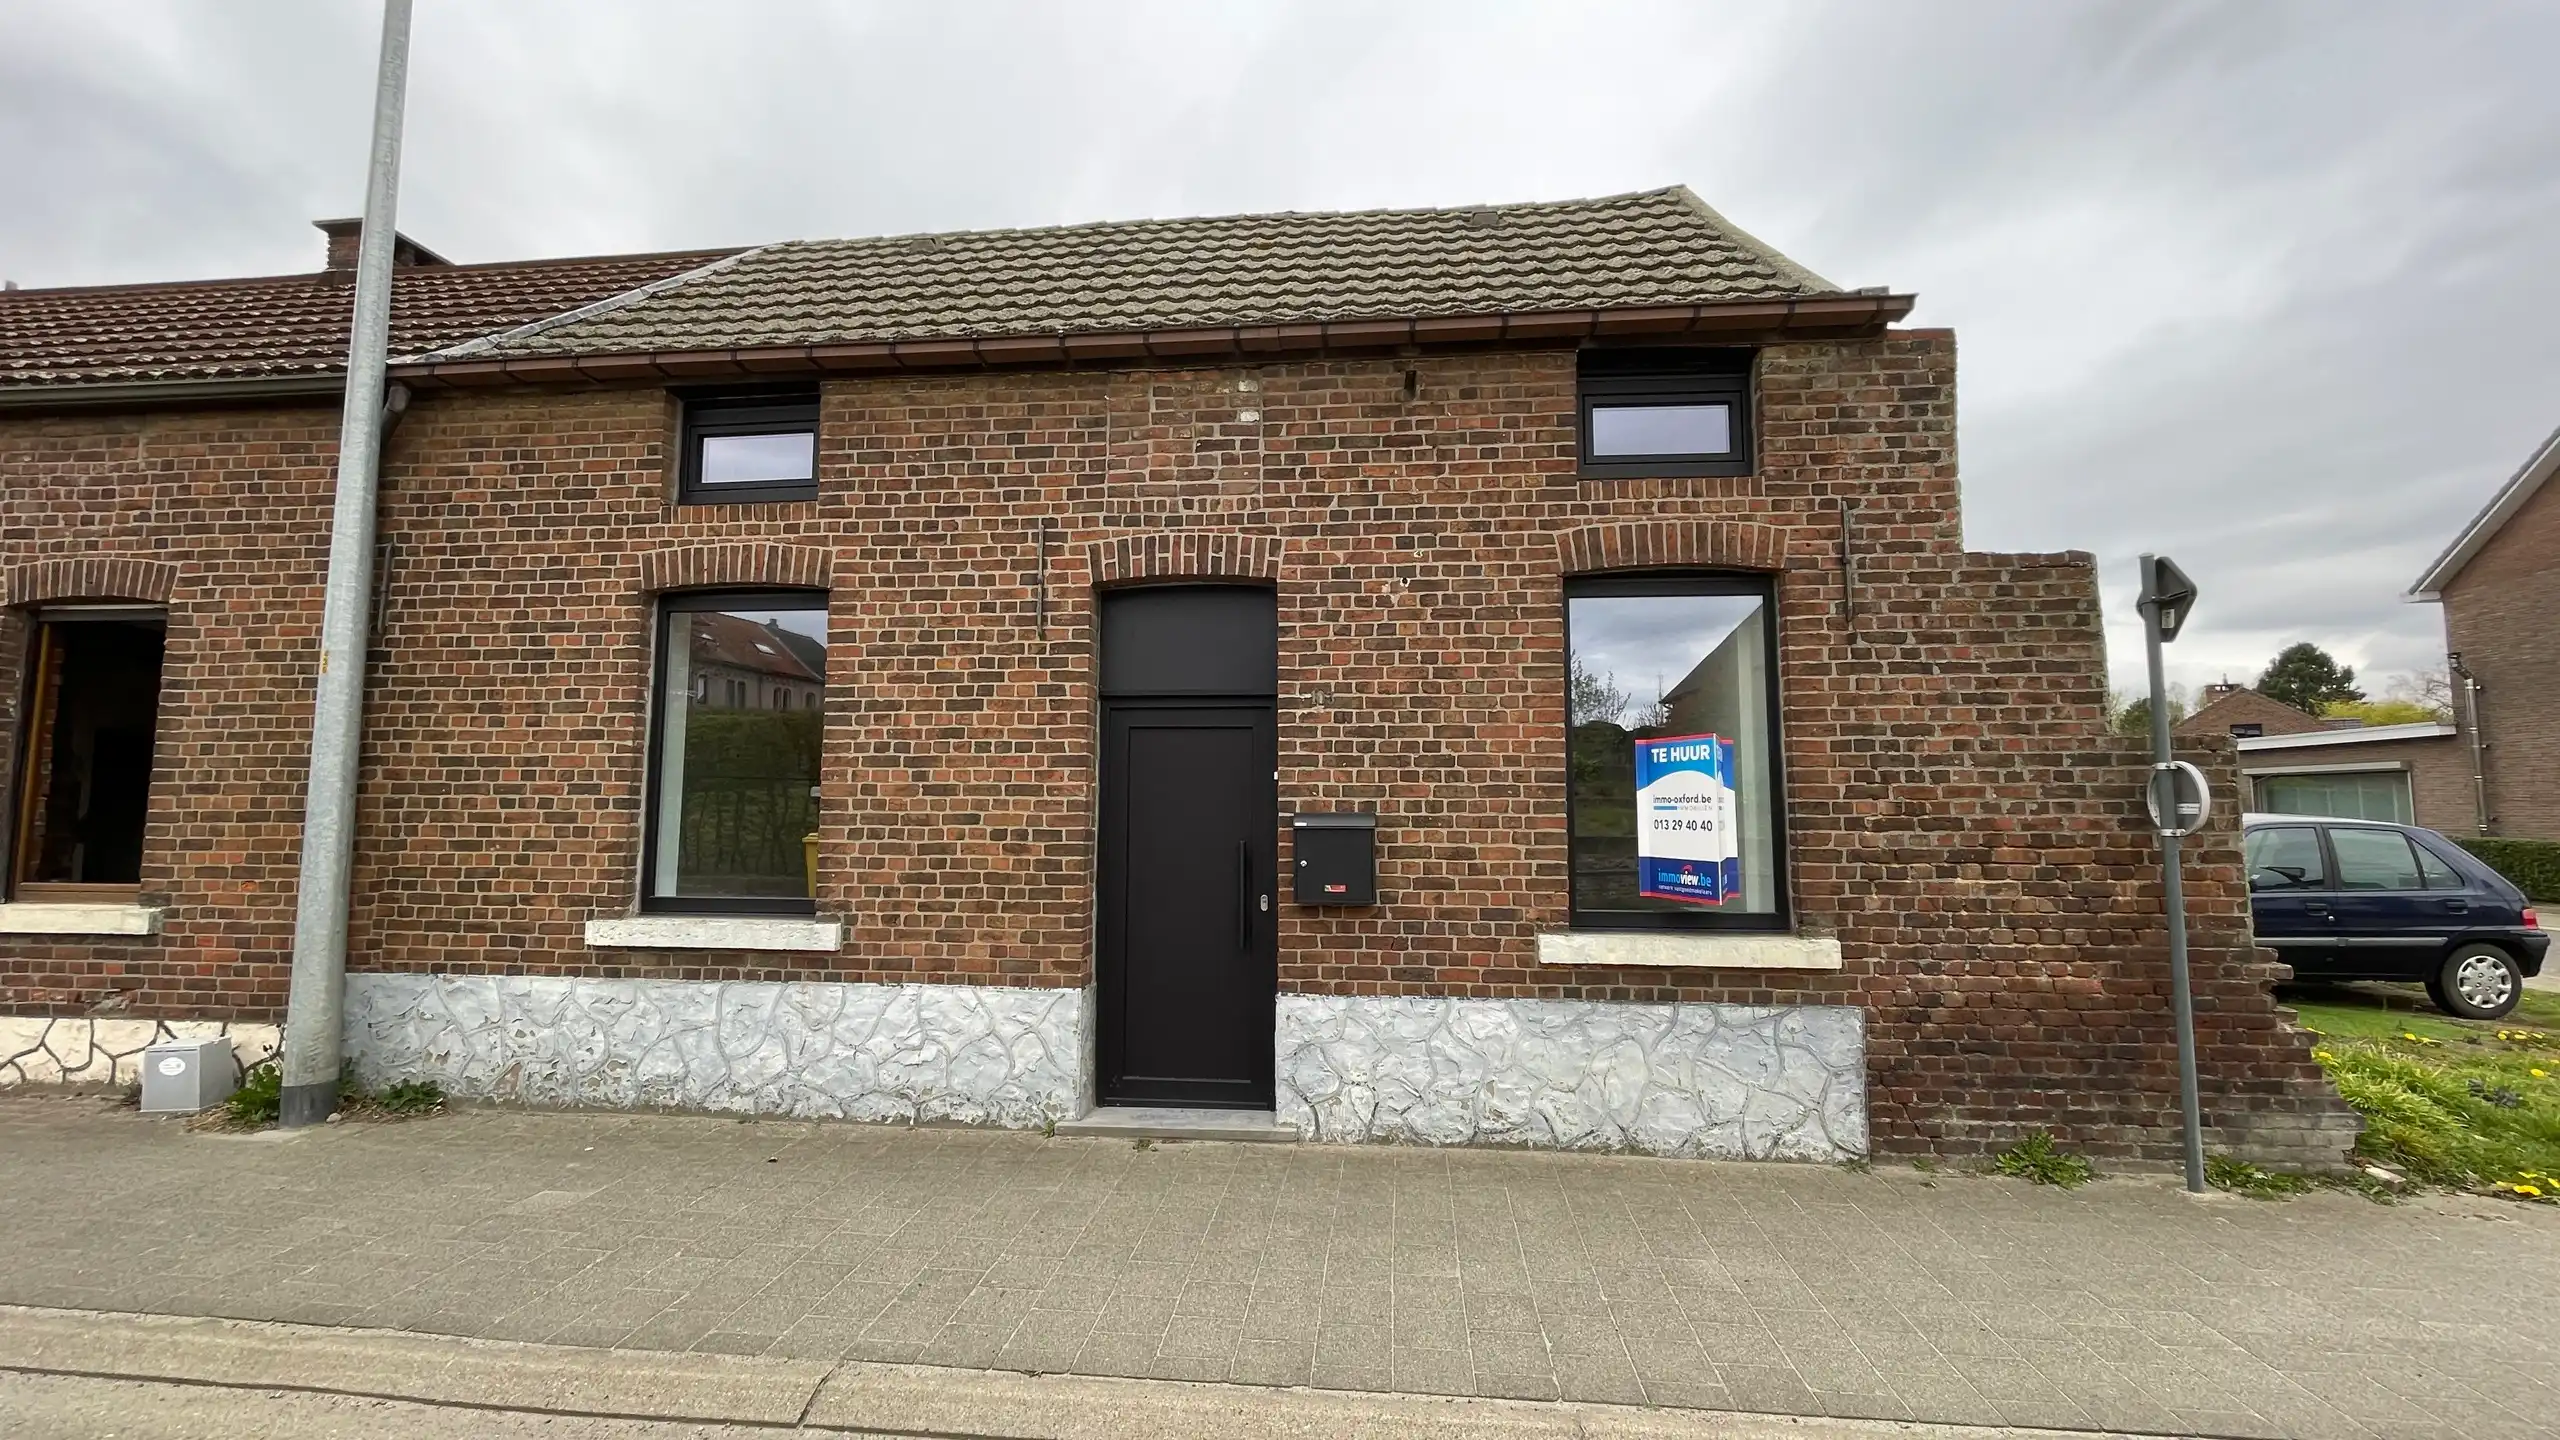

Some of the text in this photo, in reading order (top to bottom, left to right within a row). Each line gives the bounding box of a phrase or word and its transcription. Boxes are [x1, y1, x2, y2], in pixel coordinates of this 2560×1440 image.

[1651, 748, 1667, 763] TE
[1670, 744, 1711, 762] HUUR
[1653, 793, 1712, 804] immo-oxford.be
[1654, 819, 1713, 832] 013 29 40 40
[1658, 868, 1712, 887] immoview.be
